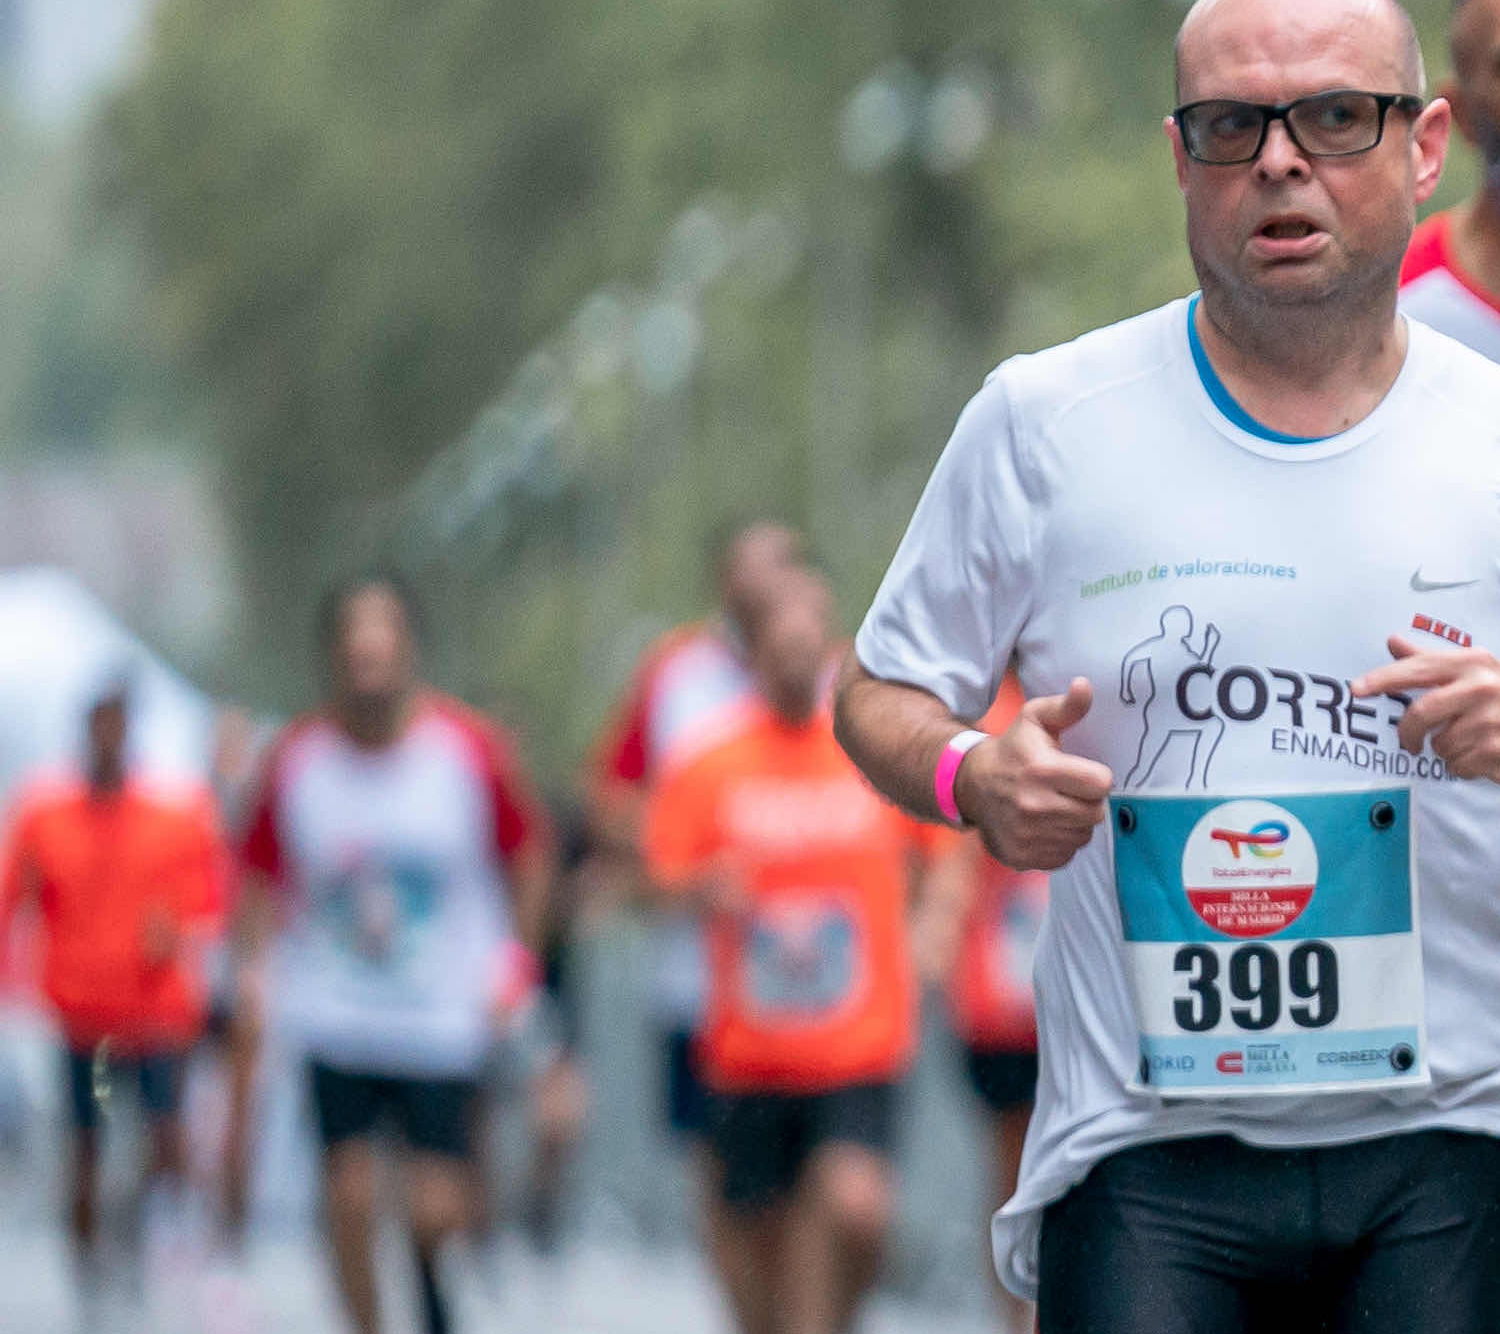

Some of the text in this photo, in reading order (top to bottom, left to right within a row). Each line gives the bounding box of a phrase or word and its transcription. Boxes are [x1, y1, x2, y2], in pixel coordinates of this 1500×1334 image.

[1080, 558, 1297, 598] instituto de valoraciones
[1271, 728, 1459, 781] ENMADRID.CO
[1172, 939, 1339, 1033] 399
